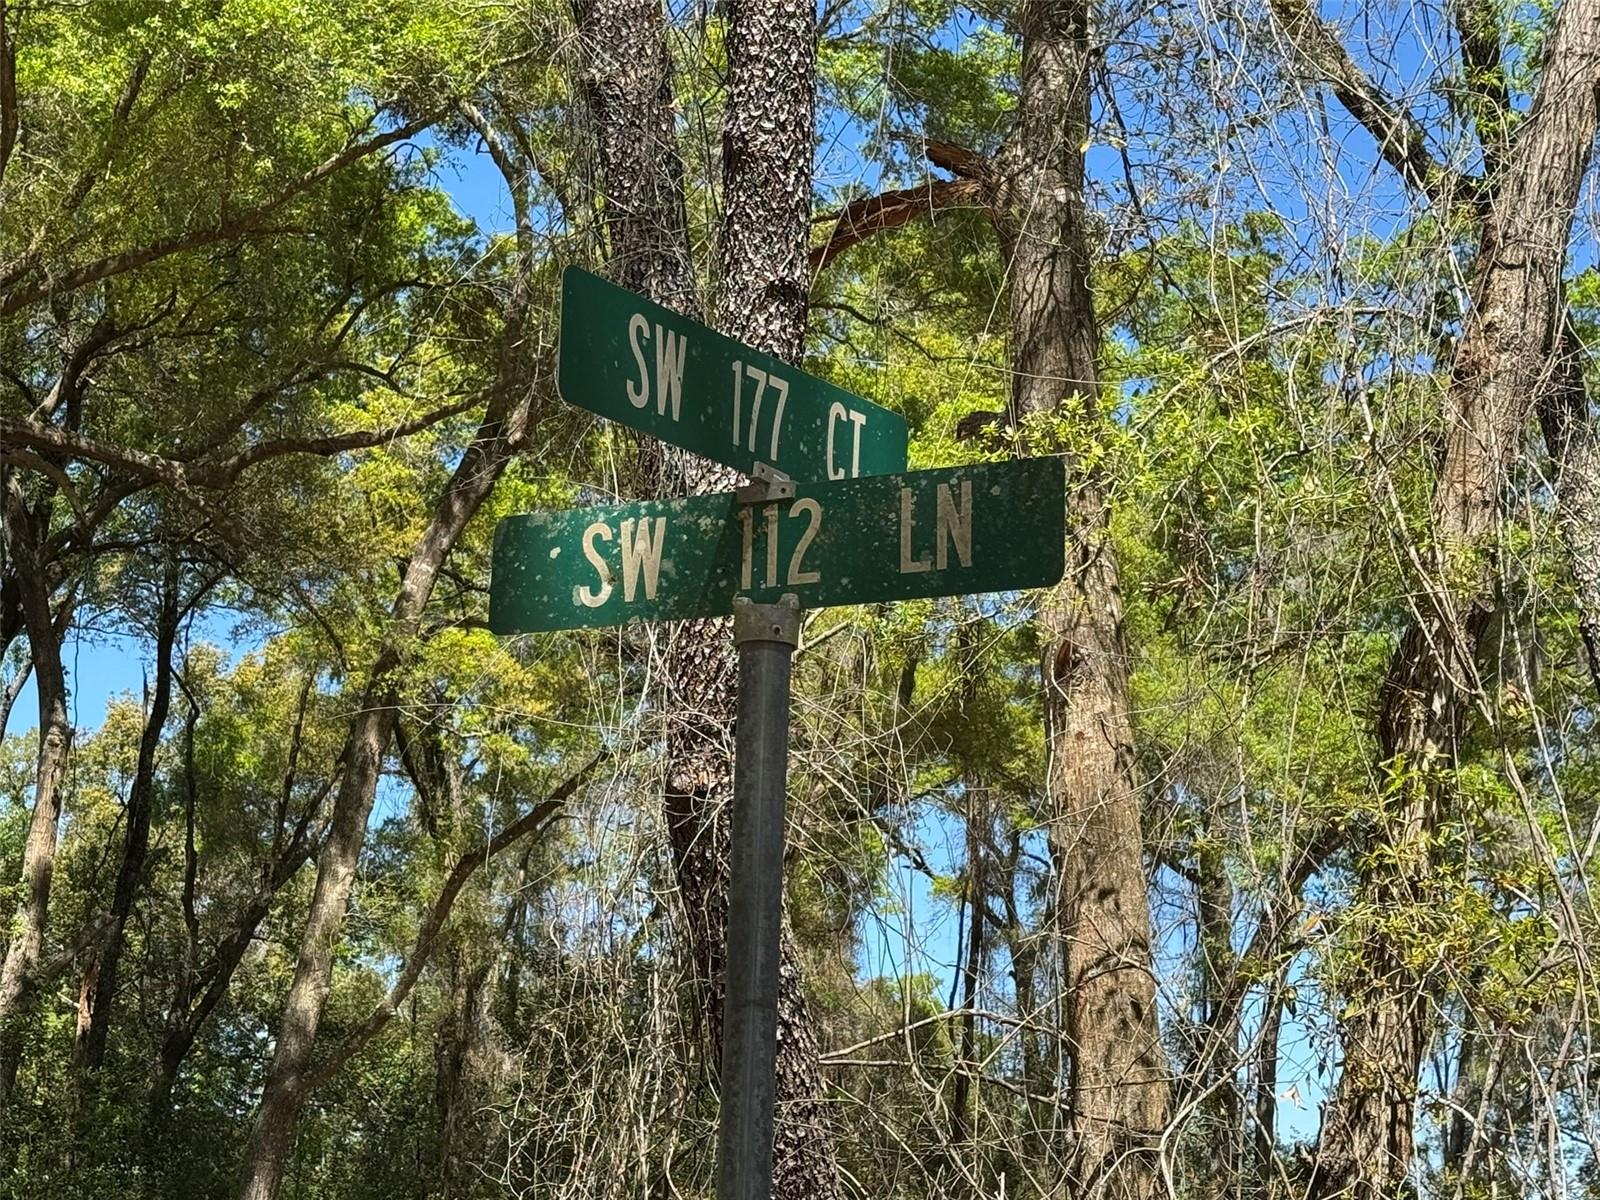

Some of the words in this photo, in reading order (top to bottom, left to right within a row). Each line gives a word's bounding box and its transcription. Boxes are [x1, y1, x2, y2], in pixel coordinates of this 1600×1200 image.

[626, 312, 687, 422] SW
[732, 360, 790, 461] 177
[826, 401, 867, 481] CT
[579, 516, 666, 608] SW
[739, 497, 822, 590] 112
[900, 480, 973, 574] LN
